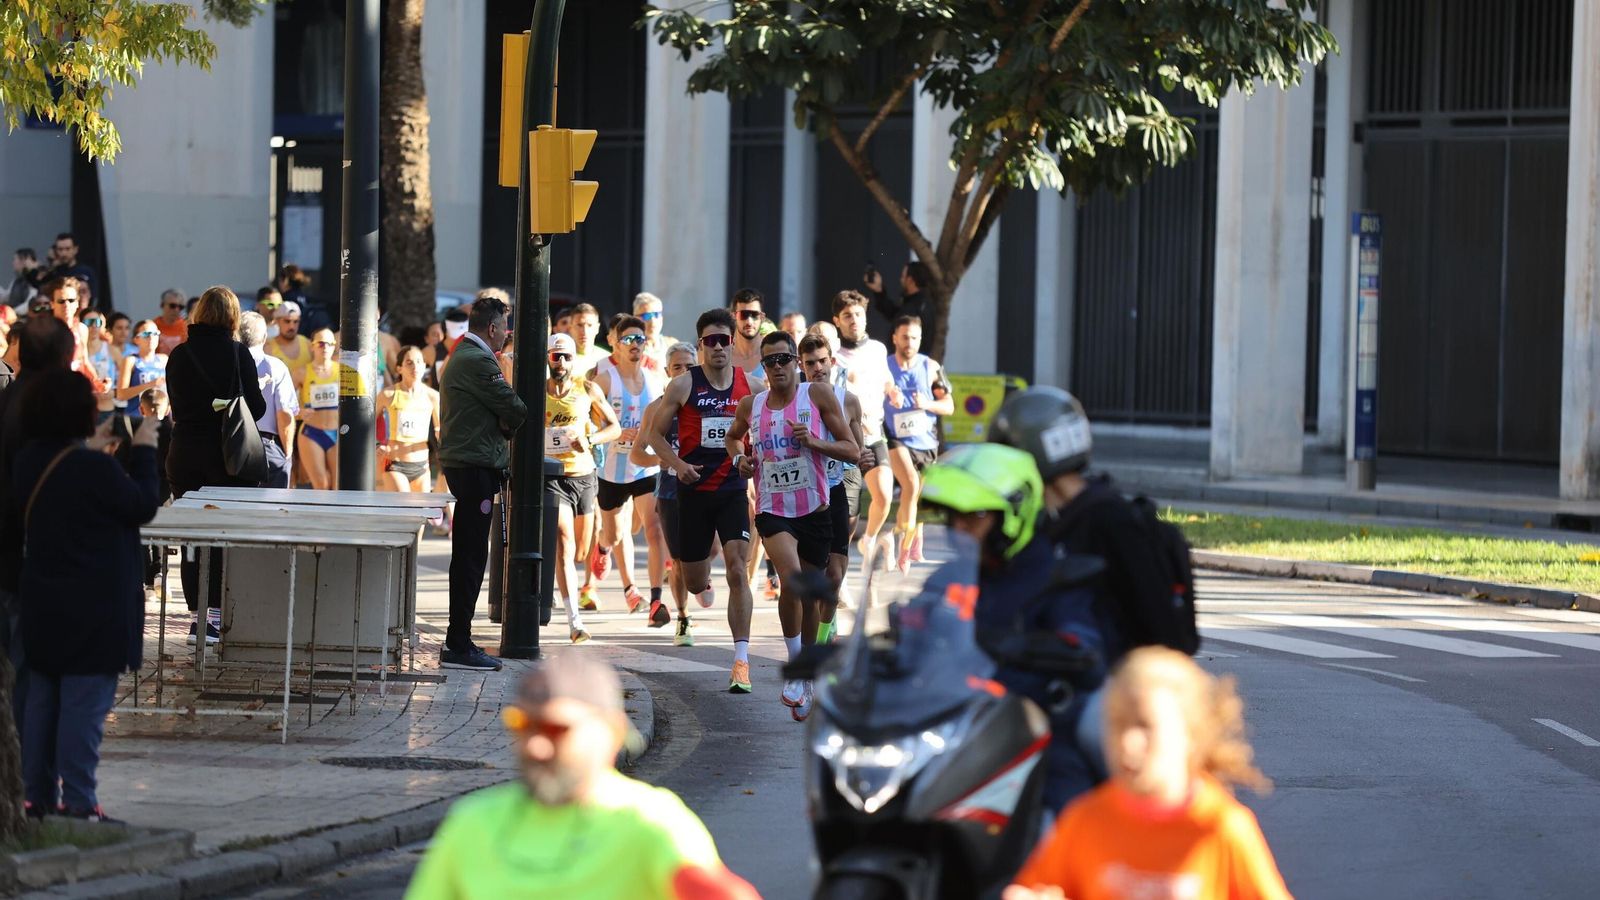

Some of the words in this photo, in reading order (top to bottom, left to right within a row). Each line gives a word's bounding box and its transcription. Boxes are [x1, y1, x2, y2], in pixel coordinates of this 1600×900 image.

[314, 391, 336, 401] 680
[697, 398, 718, 407] RFC
[725, 397, 739, 406] Liè
[552, 436, 561, 446] 5
[754, 433, 802, 453] málag
[770, 469, 800, 484] 117
